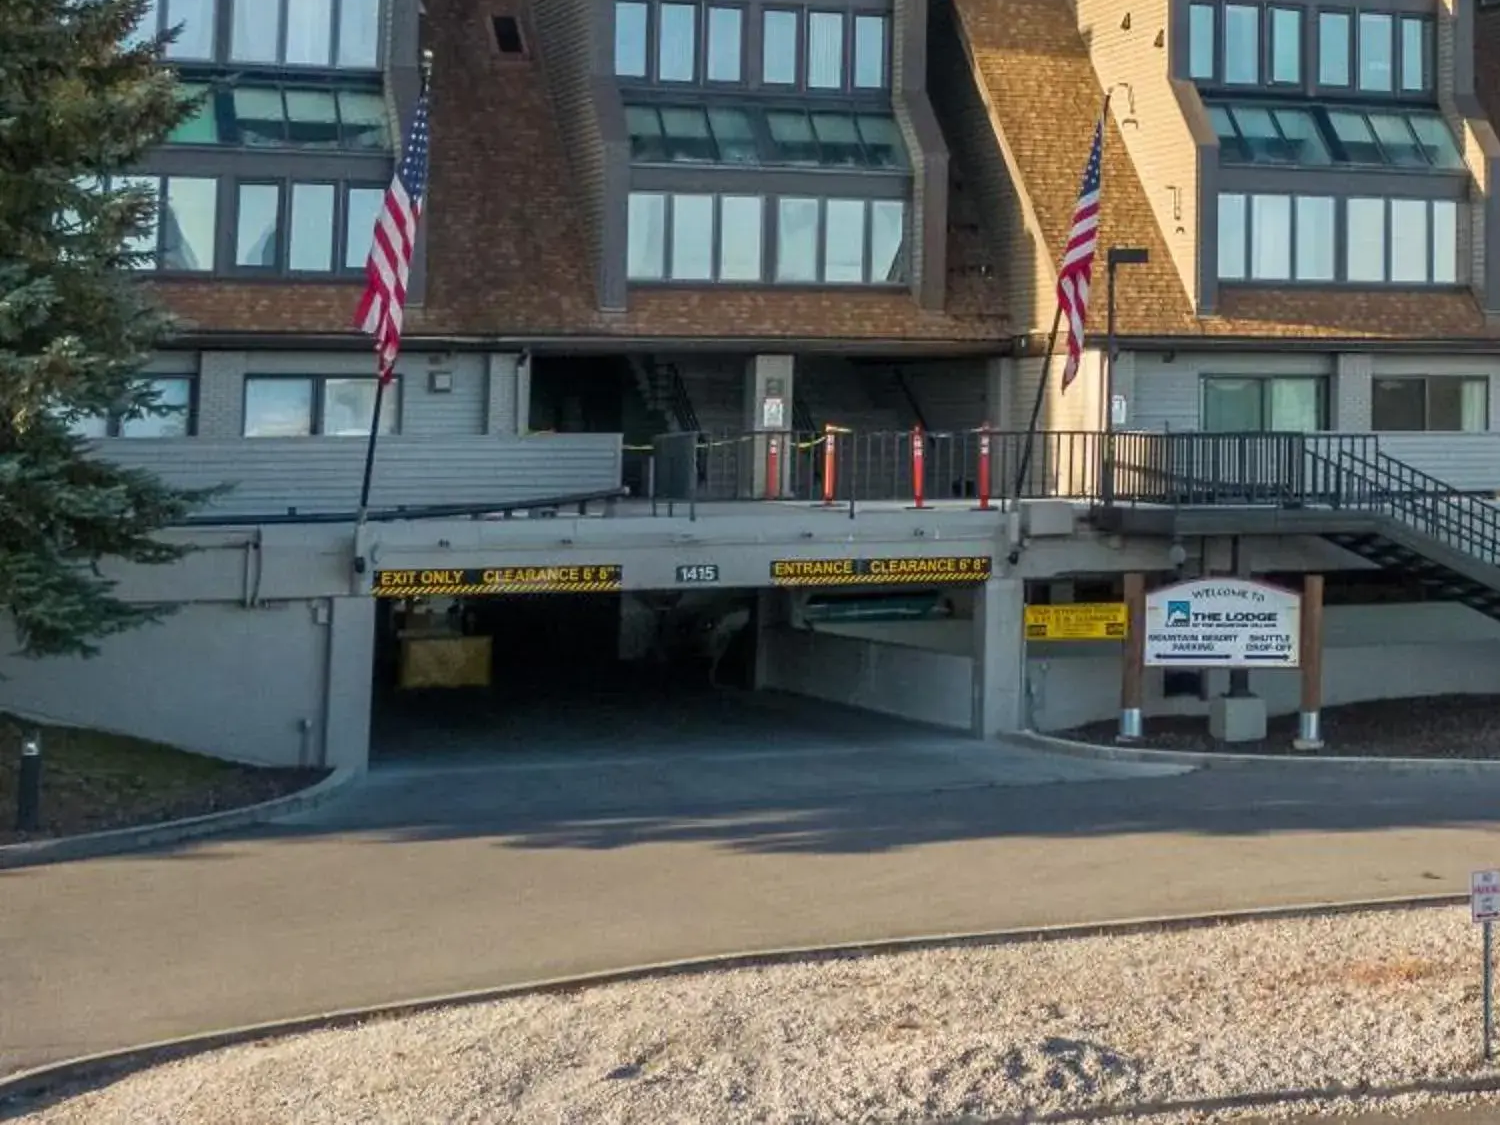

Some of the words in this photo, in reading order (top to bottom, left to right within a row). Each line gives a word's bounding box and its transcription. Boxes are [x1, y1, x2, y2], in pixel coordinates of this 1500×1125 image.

[775, 561, 853, 575] ENTRANCE
[870, 559, 956, 574] CLEARANCE
[381, 571, 416, 586] EXIT
[421, 570, 465, 584] ONLY
[483, 567, 579, 583] CLEARANCE
[681, 566, 715, 581] 1415
[1191, 588, 1248, 599] WELCOME
[1192, 612, 1222, 622] THE
[1225, 612, 1278, 622] LODGE
[1149, 634, 1199, 642] MOUNTAIN
[1201, 634, 1239, 642] RESORT
[1248, 634, 1291, 642] SHUTTLE
[1172, 643, 1215, 651] PARKING
[1245, 643, 1292, 652] DROP-OFF
